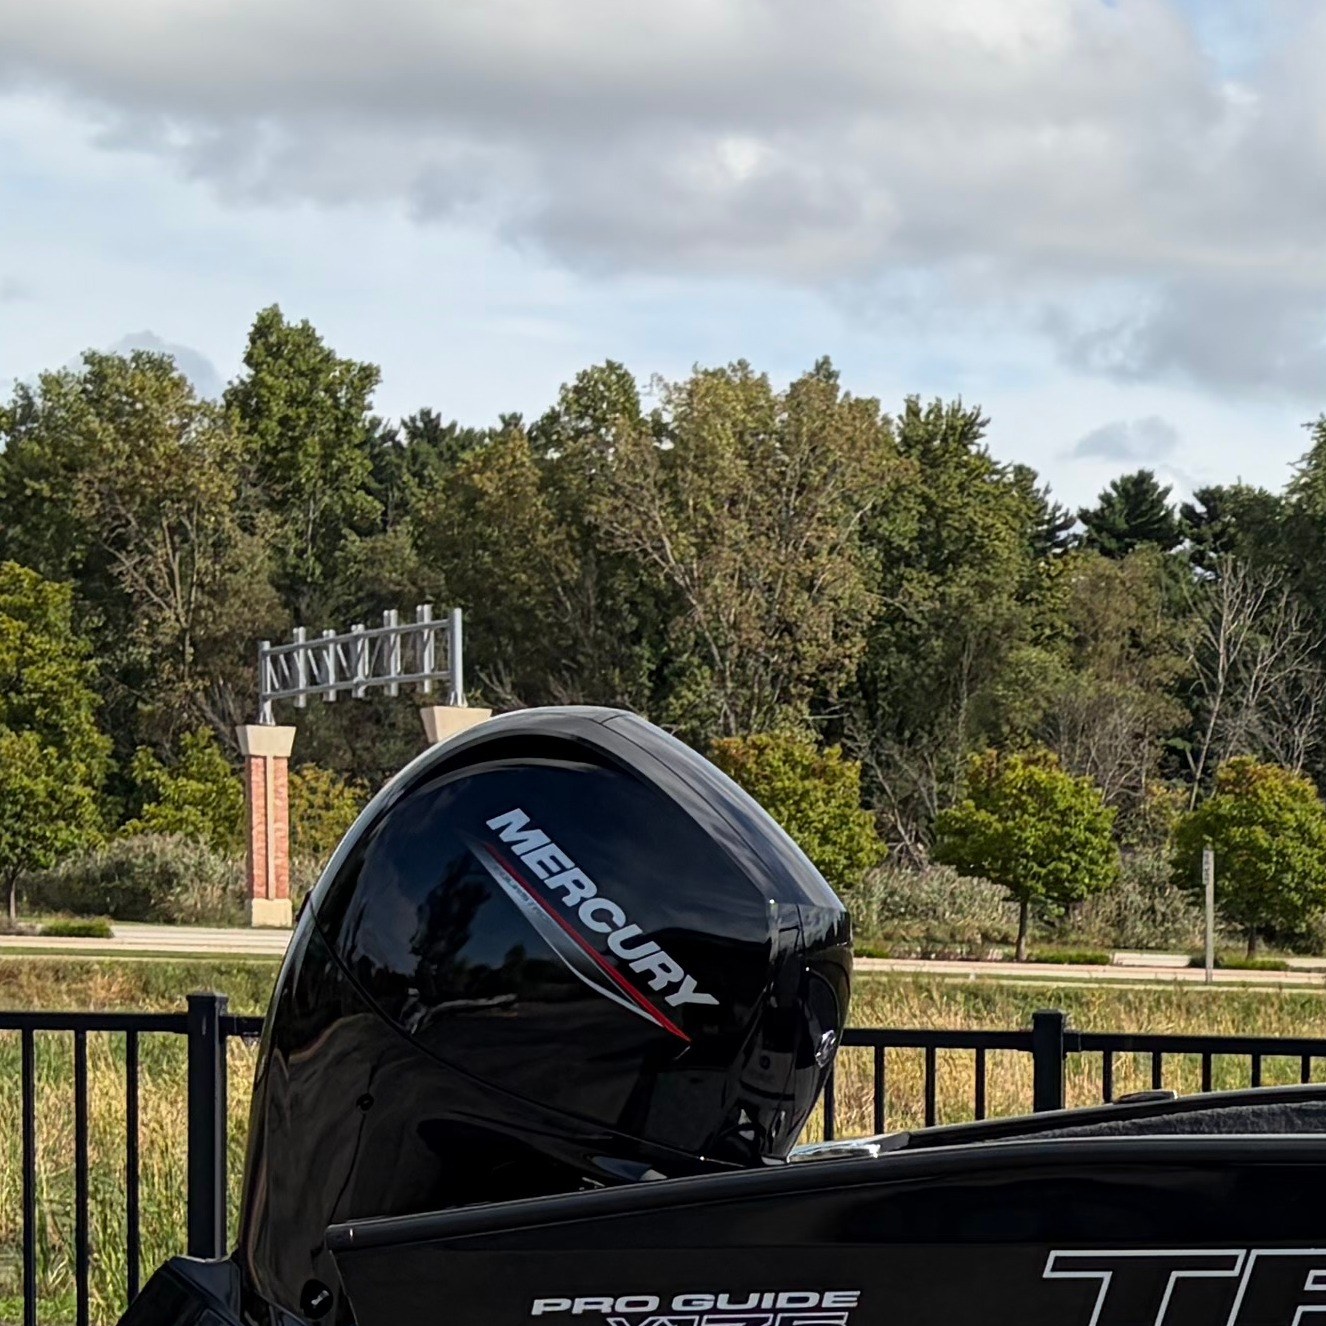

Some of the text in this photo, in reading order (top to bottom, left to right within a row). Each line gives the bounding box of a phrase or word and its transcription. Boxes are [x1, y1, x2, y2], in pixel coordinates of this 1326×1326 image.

[486, 808, 720, 1008] MERCURY
[530, 1290, 862, 1316] PRO GUIDE
